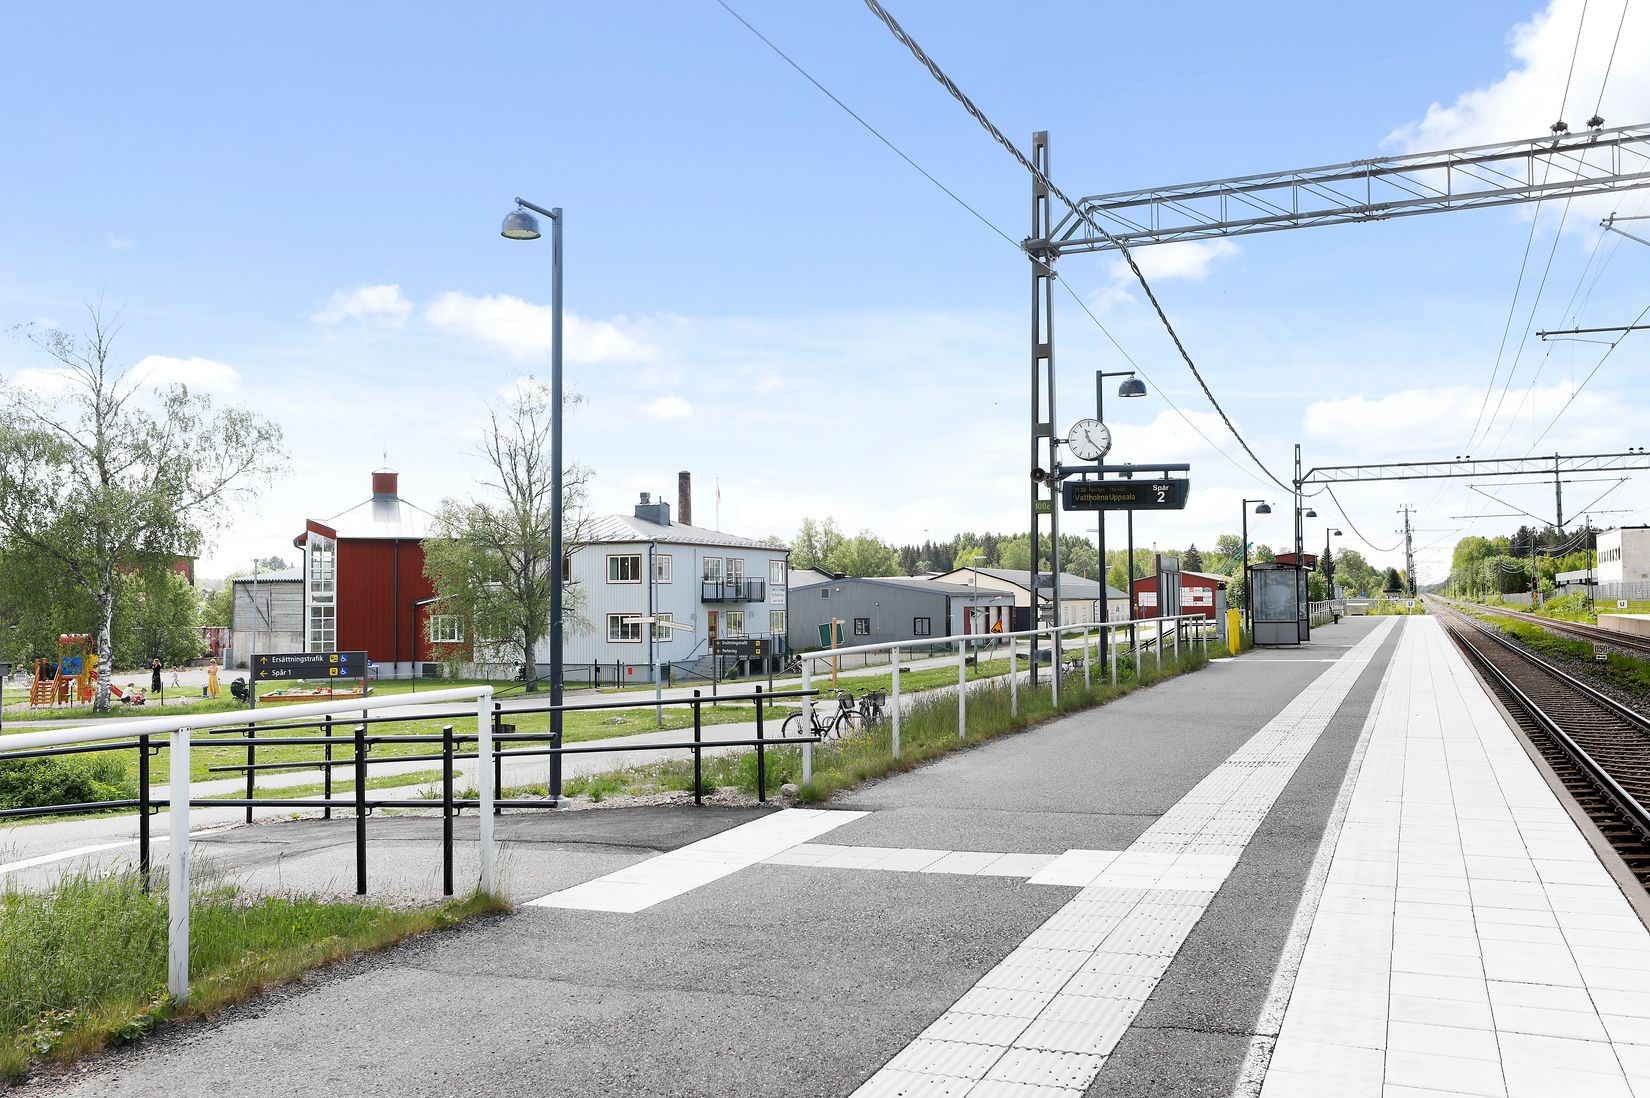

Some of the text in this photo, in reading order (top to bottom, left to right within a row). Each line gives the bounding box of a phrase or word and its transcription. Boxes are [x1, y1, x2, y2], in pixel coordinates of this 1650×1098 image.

[1152, 484, 1170, 492] Spår
[1109, 493, 1136, 502] Uppsala
[1157, 491, 1165, 503] 2
[271, 655, 324, 664] Ersättningstrafik
[271, 669, 287, 677] Spår
